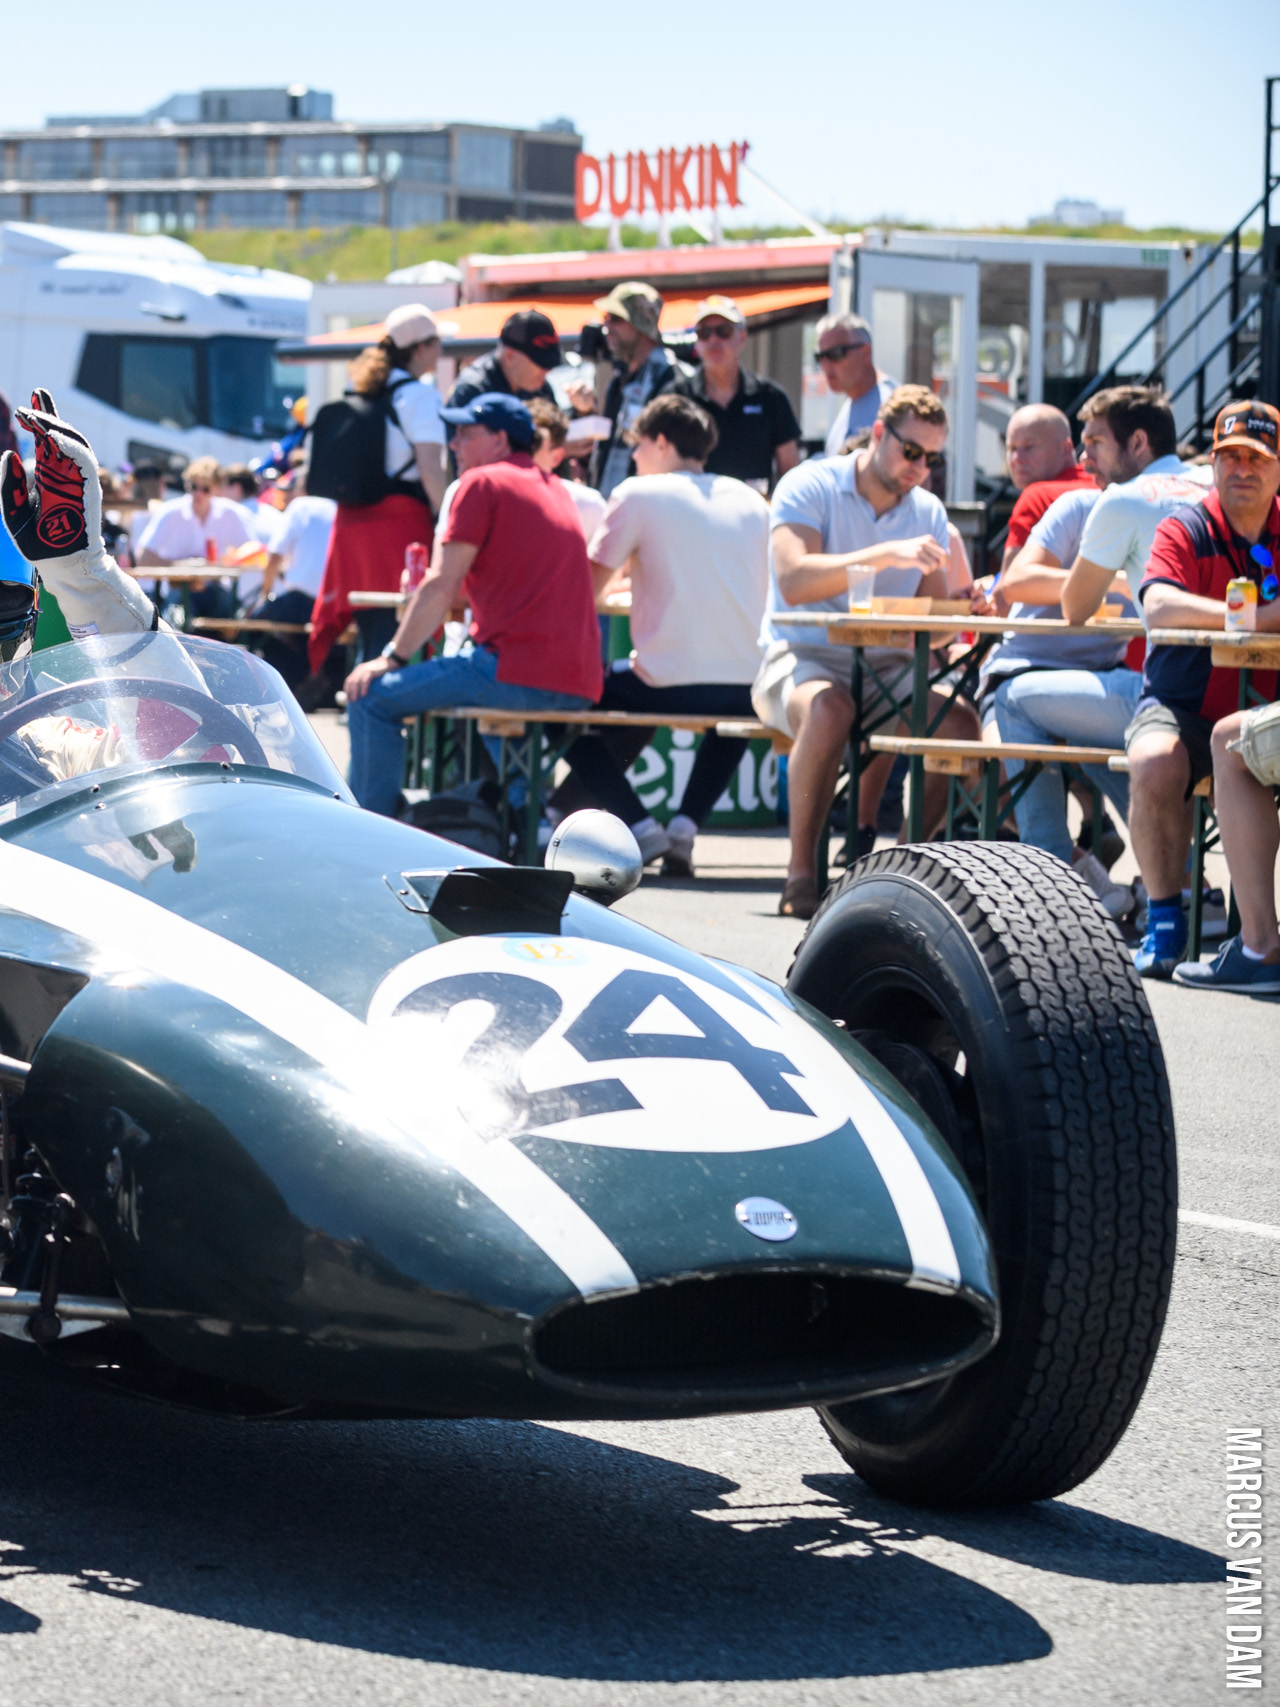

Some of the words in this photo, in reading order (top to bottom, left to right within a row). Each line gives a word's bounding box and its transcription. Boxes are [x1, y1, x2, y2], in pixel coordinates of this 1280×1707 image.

[575, 140, 749, 223] DUNKIN'
[46, 514, 72, 538] 21
[391, 967, 819, 1144] 24
